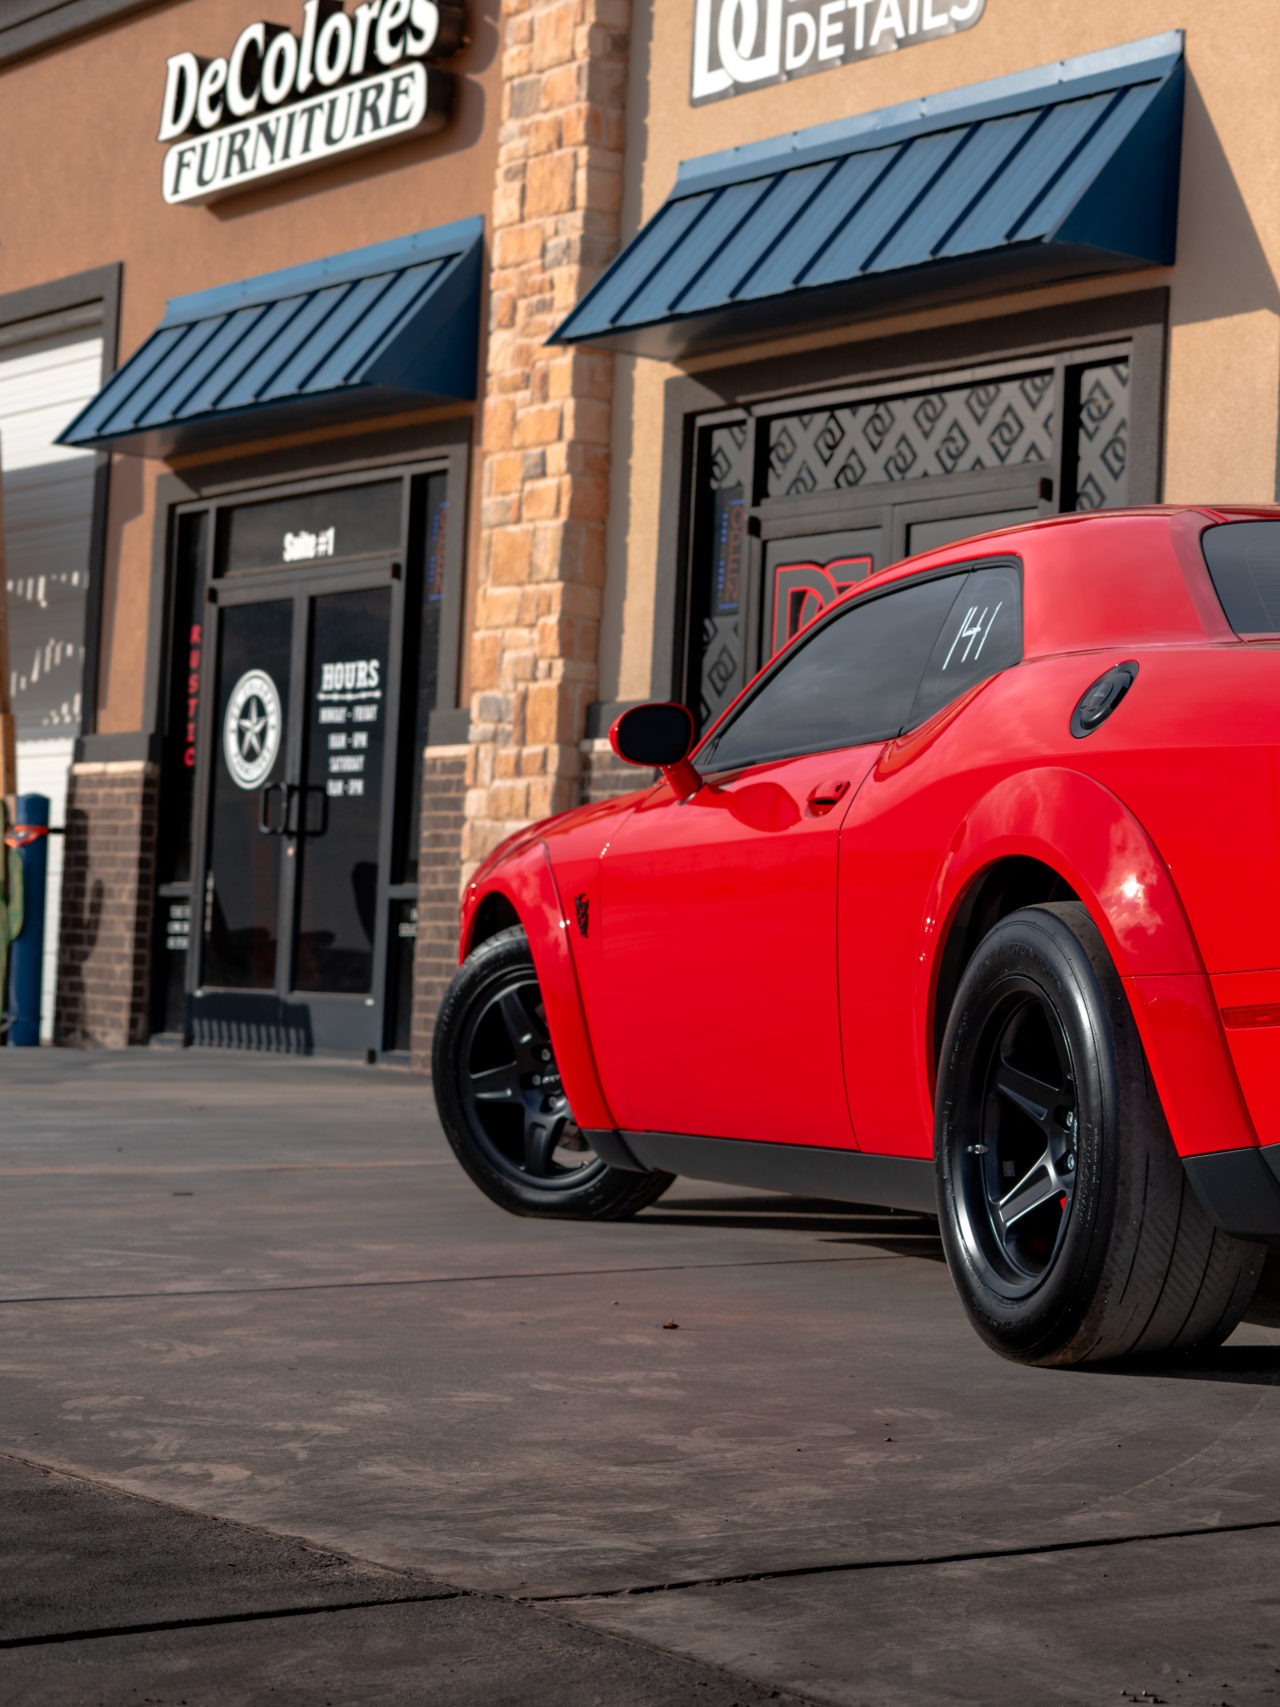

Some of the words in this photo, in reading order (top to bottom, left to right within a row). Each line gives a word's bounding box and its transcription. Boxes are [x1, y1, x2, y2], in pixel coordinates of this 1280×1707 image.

[157, 0, 439, 142] DeColores
[171, 70, 416, 196] FURNITURE
[183, 624, 202, 768] RUSTIC
[321, 659, 380, 691] HOURS
